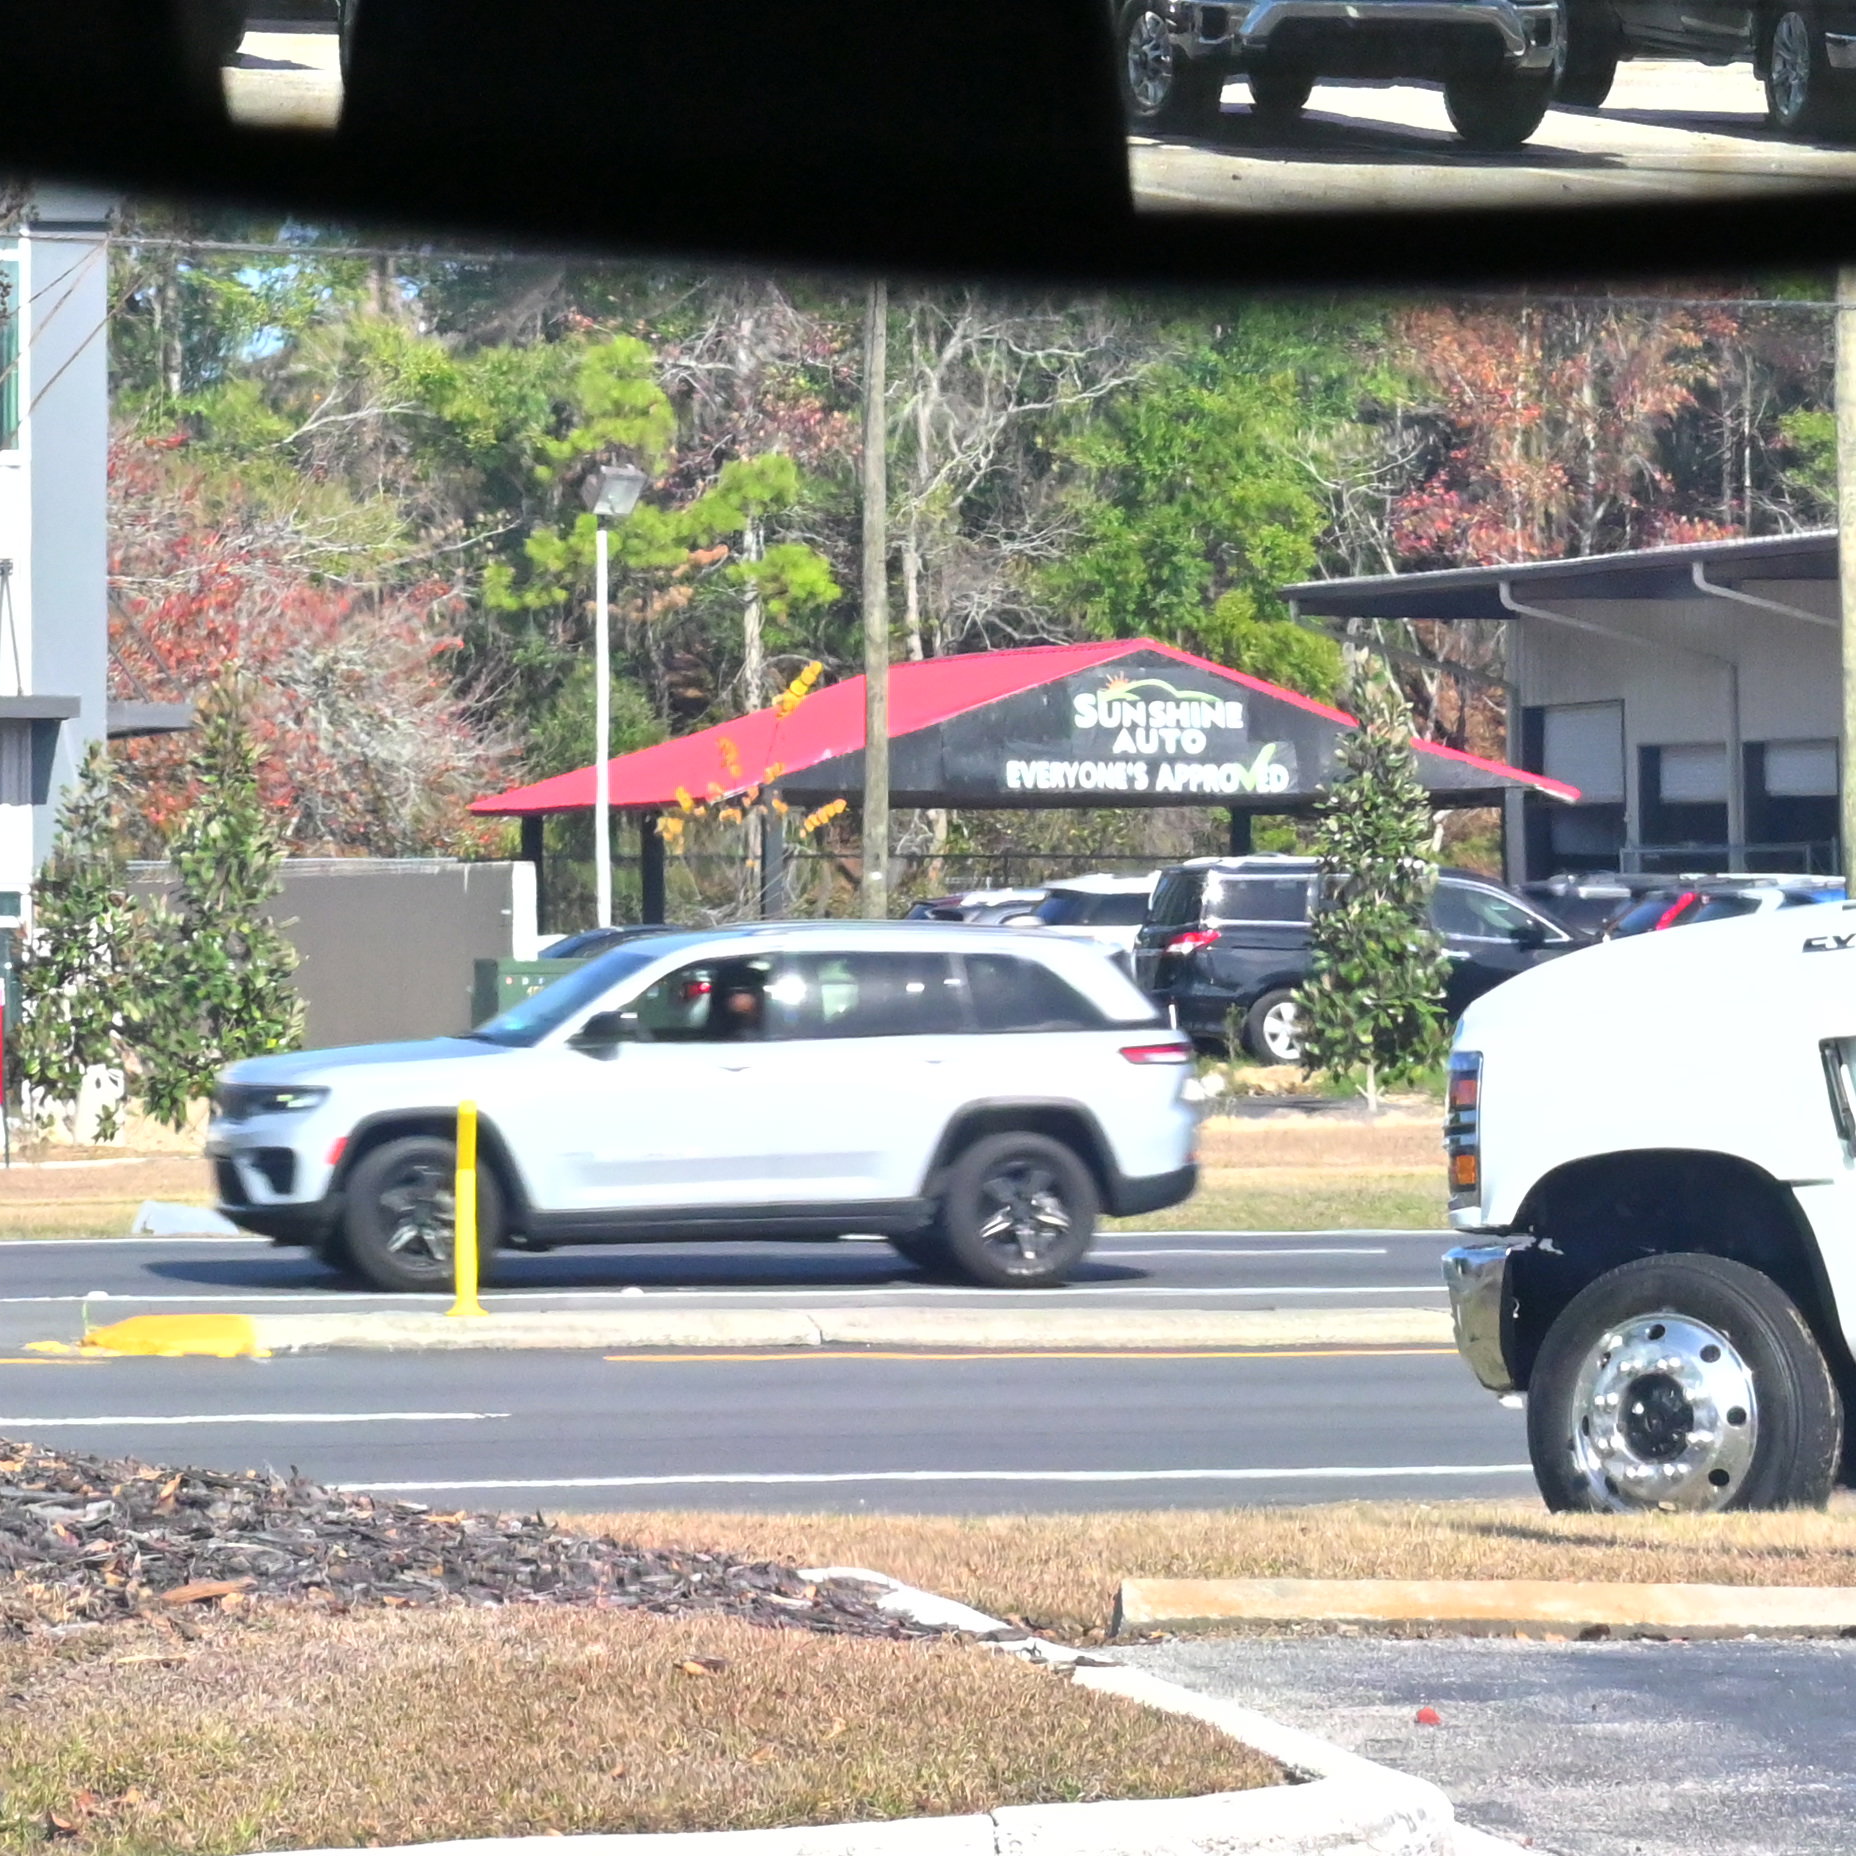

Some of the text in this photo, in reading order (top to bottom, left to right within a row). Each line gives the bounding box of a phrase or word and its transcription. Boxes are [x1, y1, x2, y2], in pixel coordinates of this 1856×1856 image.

[1073, 693, 1244, 729] SUNSHINE
[1112, 727, 1207, 754] AUTO
[1006, 760, 1149, 790] EVERYONE'S
[1155, 748, 1290, 793] APPROVED
